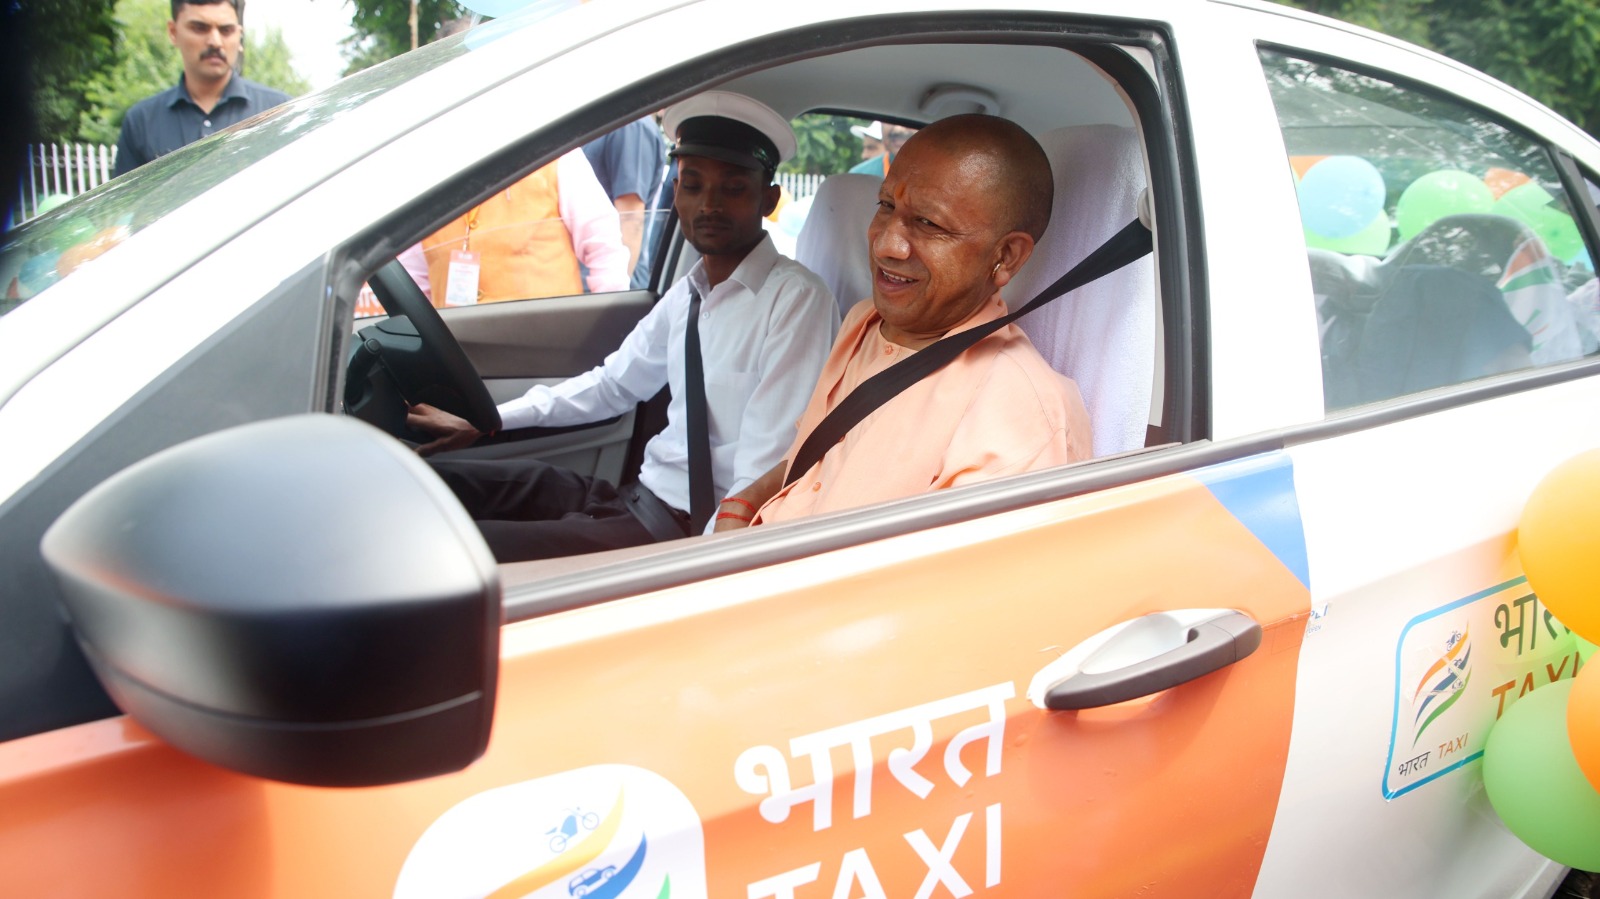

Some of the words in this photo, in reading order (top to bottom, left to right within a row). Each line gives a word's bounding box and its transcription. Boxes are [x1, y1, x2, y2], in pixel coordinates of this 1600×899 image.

[734, 680, 1016, 832] भारत
[1398, 751, 1431, 776] भारत
[1439, 732, 1468, 759] TAXI
